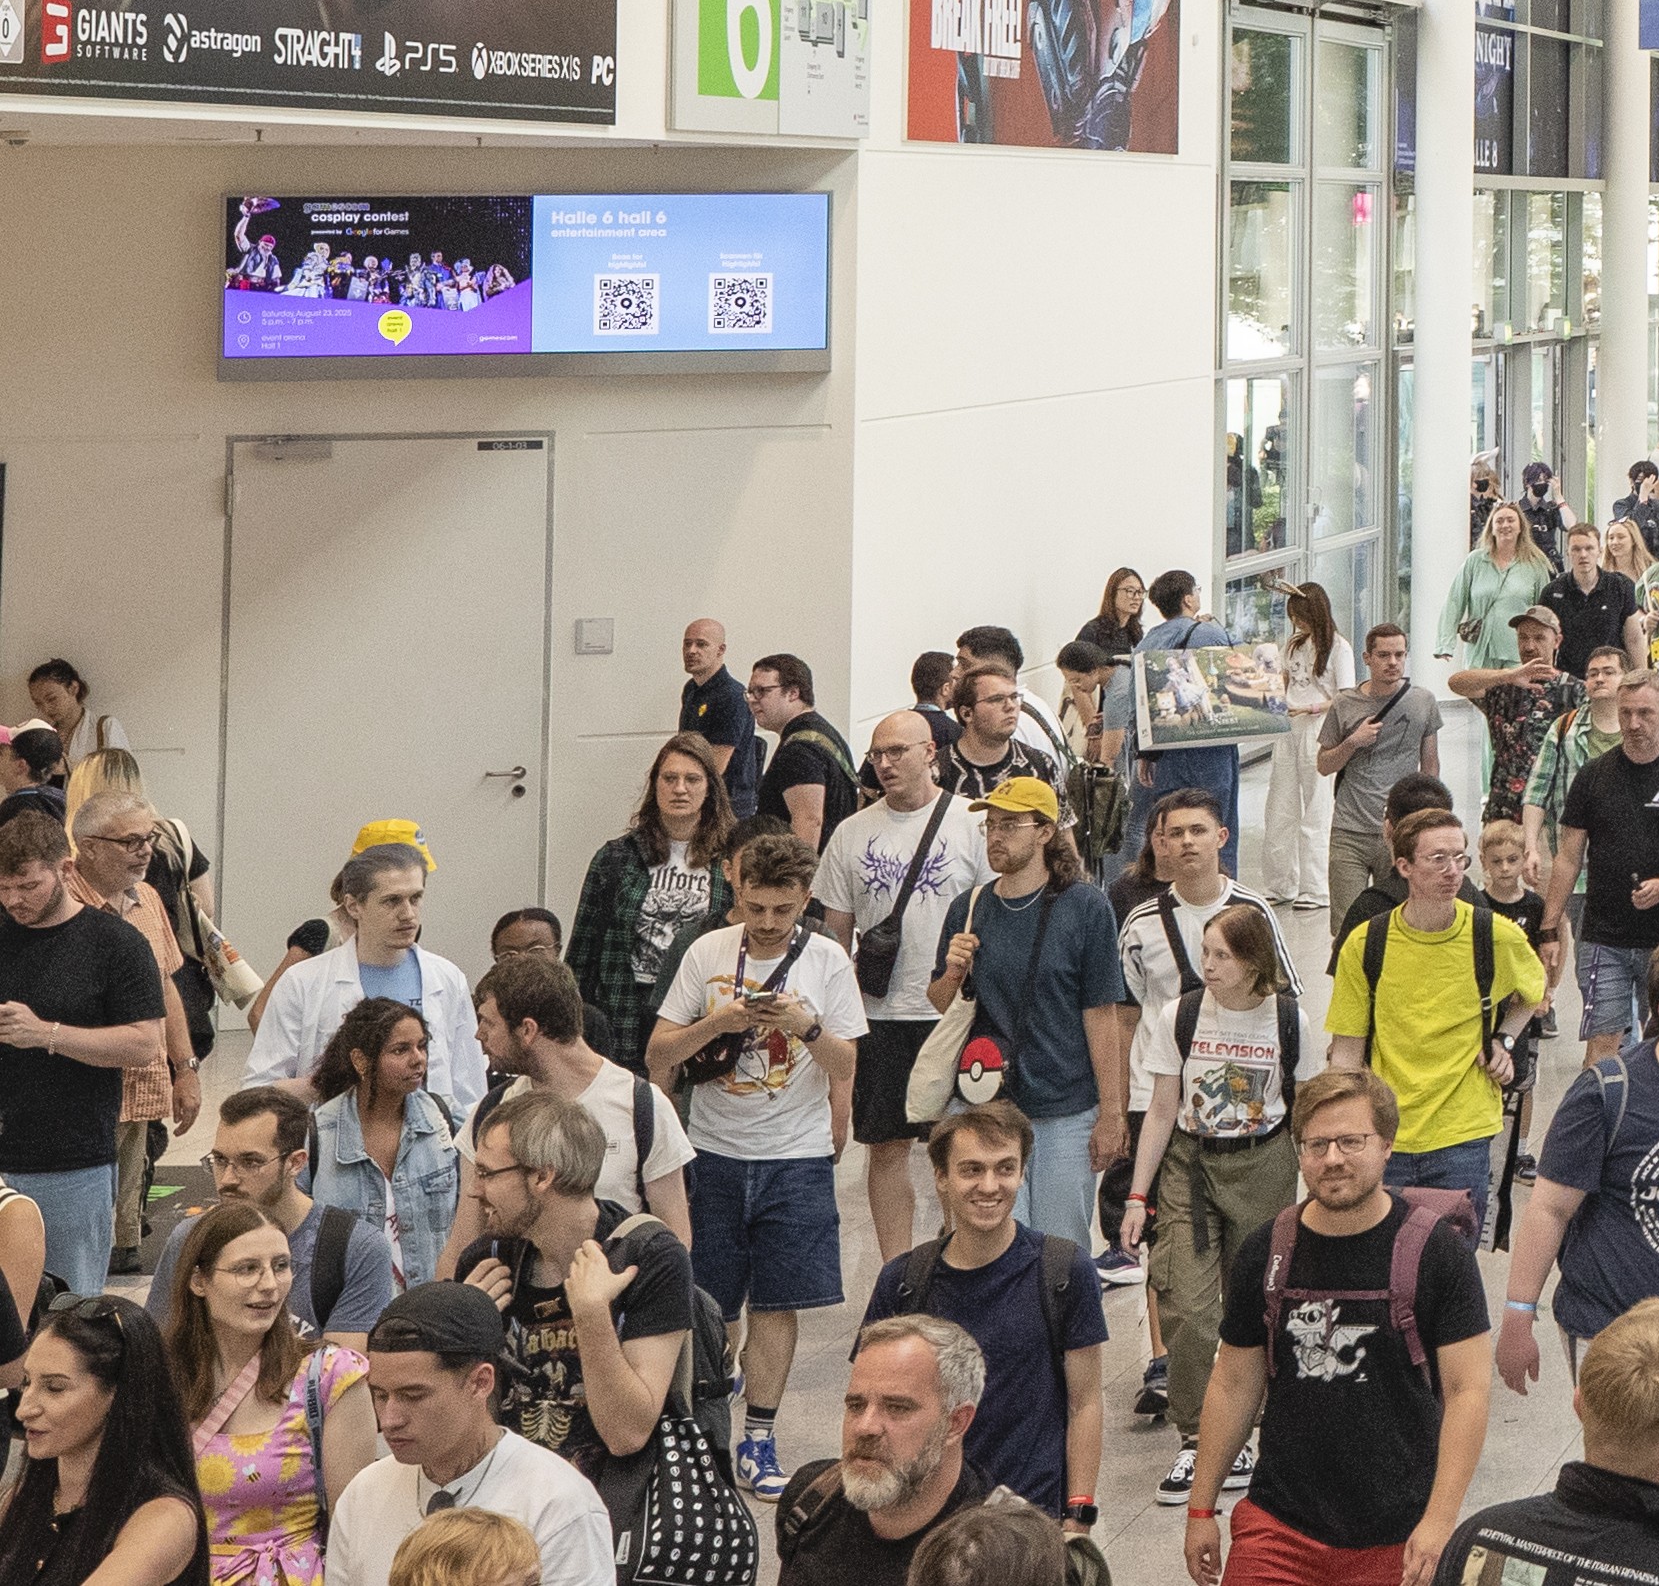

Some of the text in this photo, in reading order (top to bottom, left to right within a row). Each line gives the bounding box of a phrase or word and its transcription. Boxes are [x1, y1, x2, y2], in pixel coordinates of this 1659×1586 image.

[77, 8, 148, 45] GIANTS
[191, 27, 261, 57] astragon
[76, 44, 148, 61] SOFTWARE
[405, 41, 457, 73] PS5
[489, 50, 521, 76] XBOX
[521, 53, 559, 79] SERIES
[591, 55, 614, 86] PC
[311, 211, 407, 223] cosplay contest
[551, 211, 667, 225] Halle 6 hall 6
[382, 227, 408, 235] Games
[551, 228, 667, 238] entertainment area
[1191, 1040, 1276, 1059] TELEVISION
